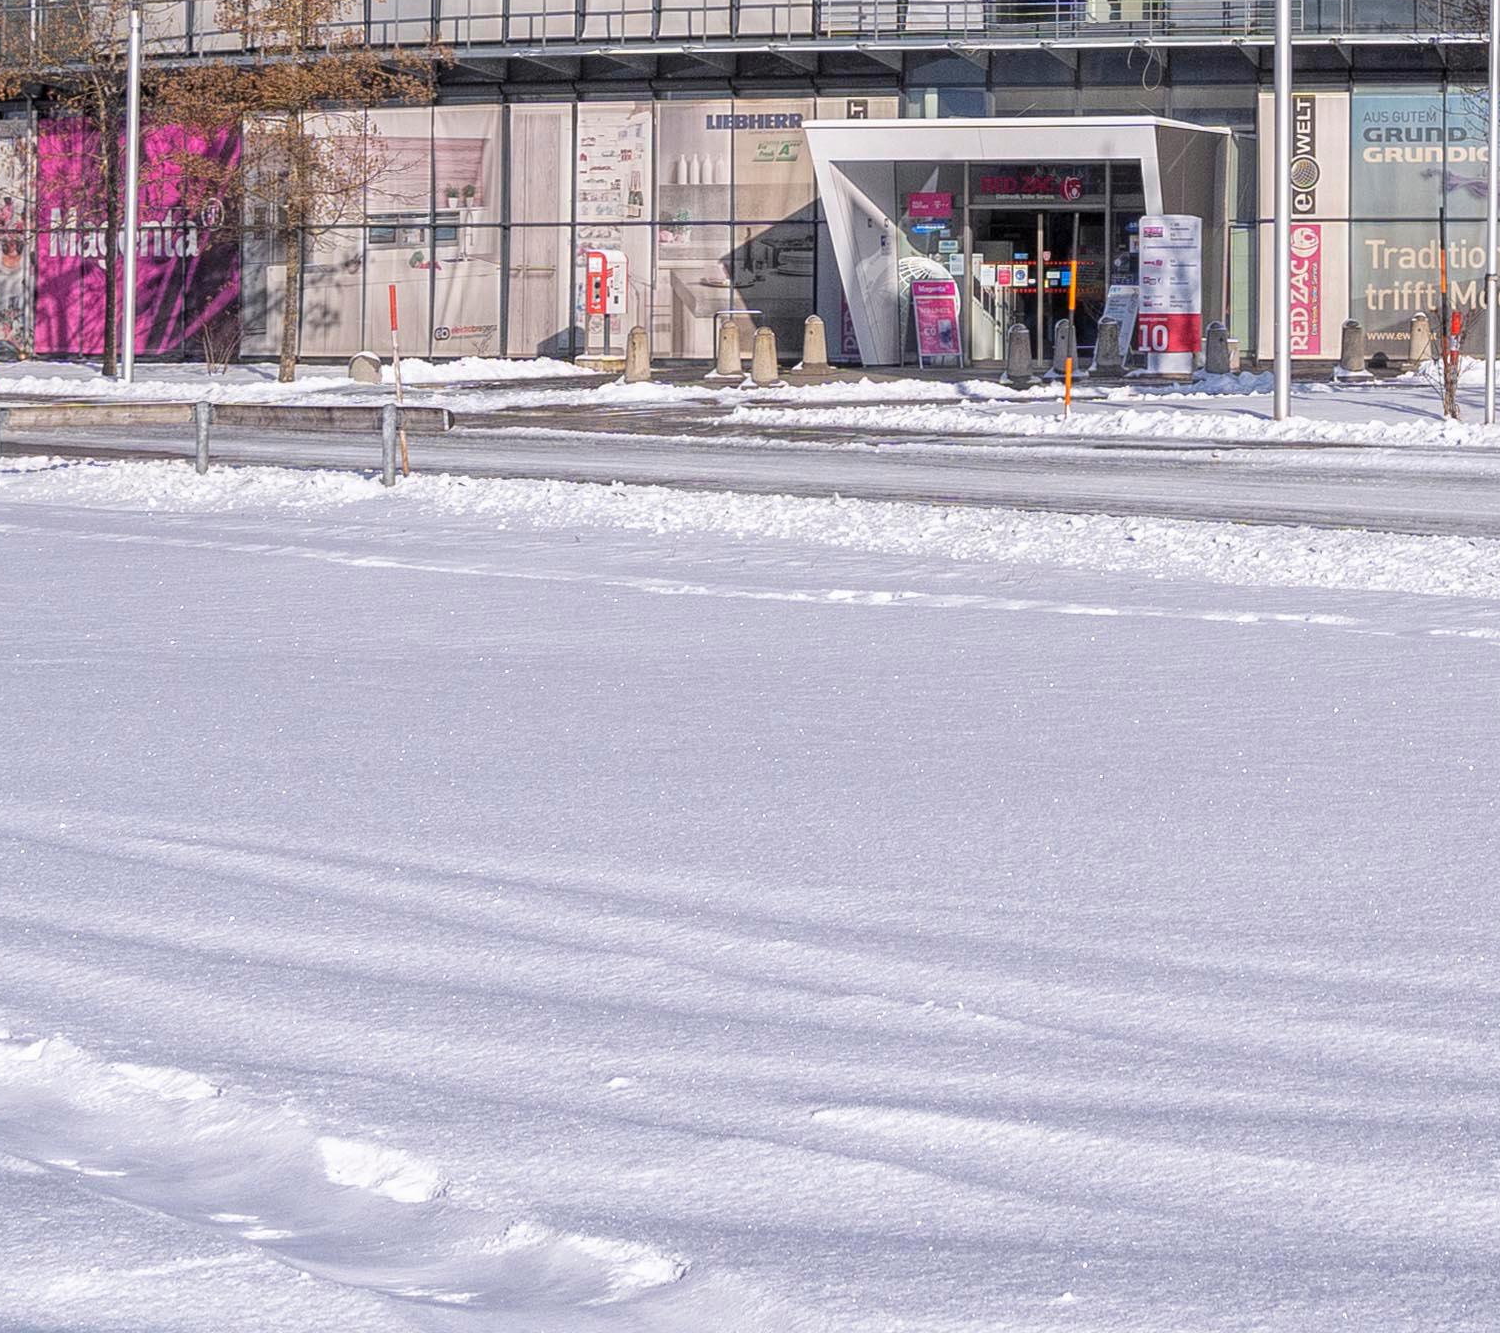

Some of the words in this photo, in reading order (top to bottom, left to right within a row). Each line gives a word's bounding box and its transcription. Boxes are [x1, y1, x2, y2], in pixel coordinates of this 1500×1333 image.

[706, 113, 804, 130] LIEBHERR
[1296, 98, 1312, 154] WELT
[1363, 111, 1389, 123] AUS
[1392, 111, 1437, 123] GUTEM
[1363, 127, 1467, 143] GRUND
[1290, 259, 1309, 304] ZAC
[1365, 283, 1437, 310] trifft
[1139, 324, 1168, 351] 10
[1290, 306, 1309, 351] RED
